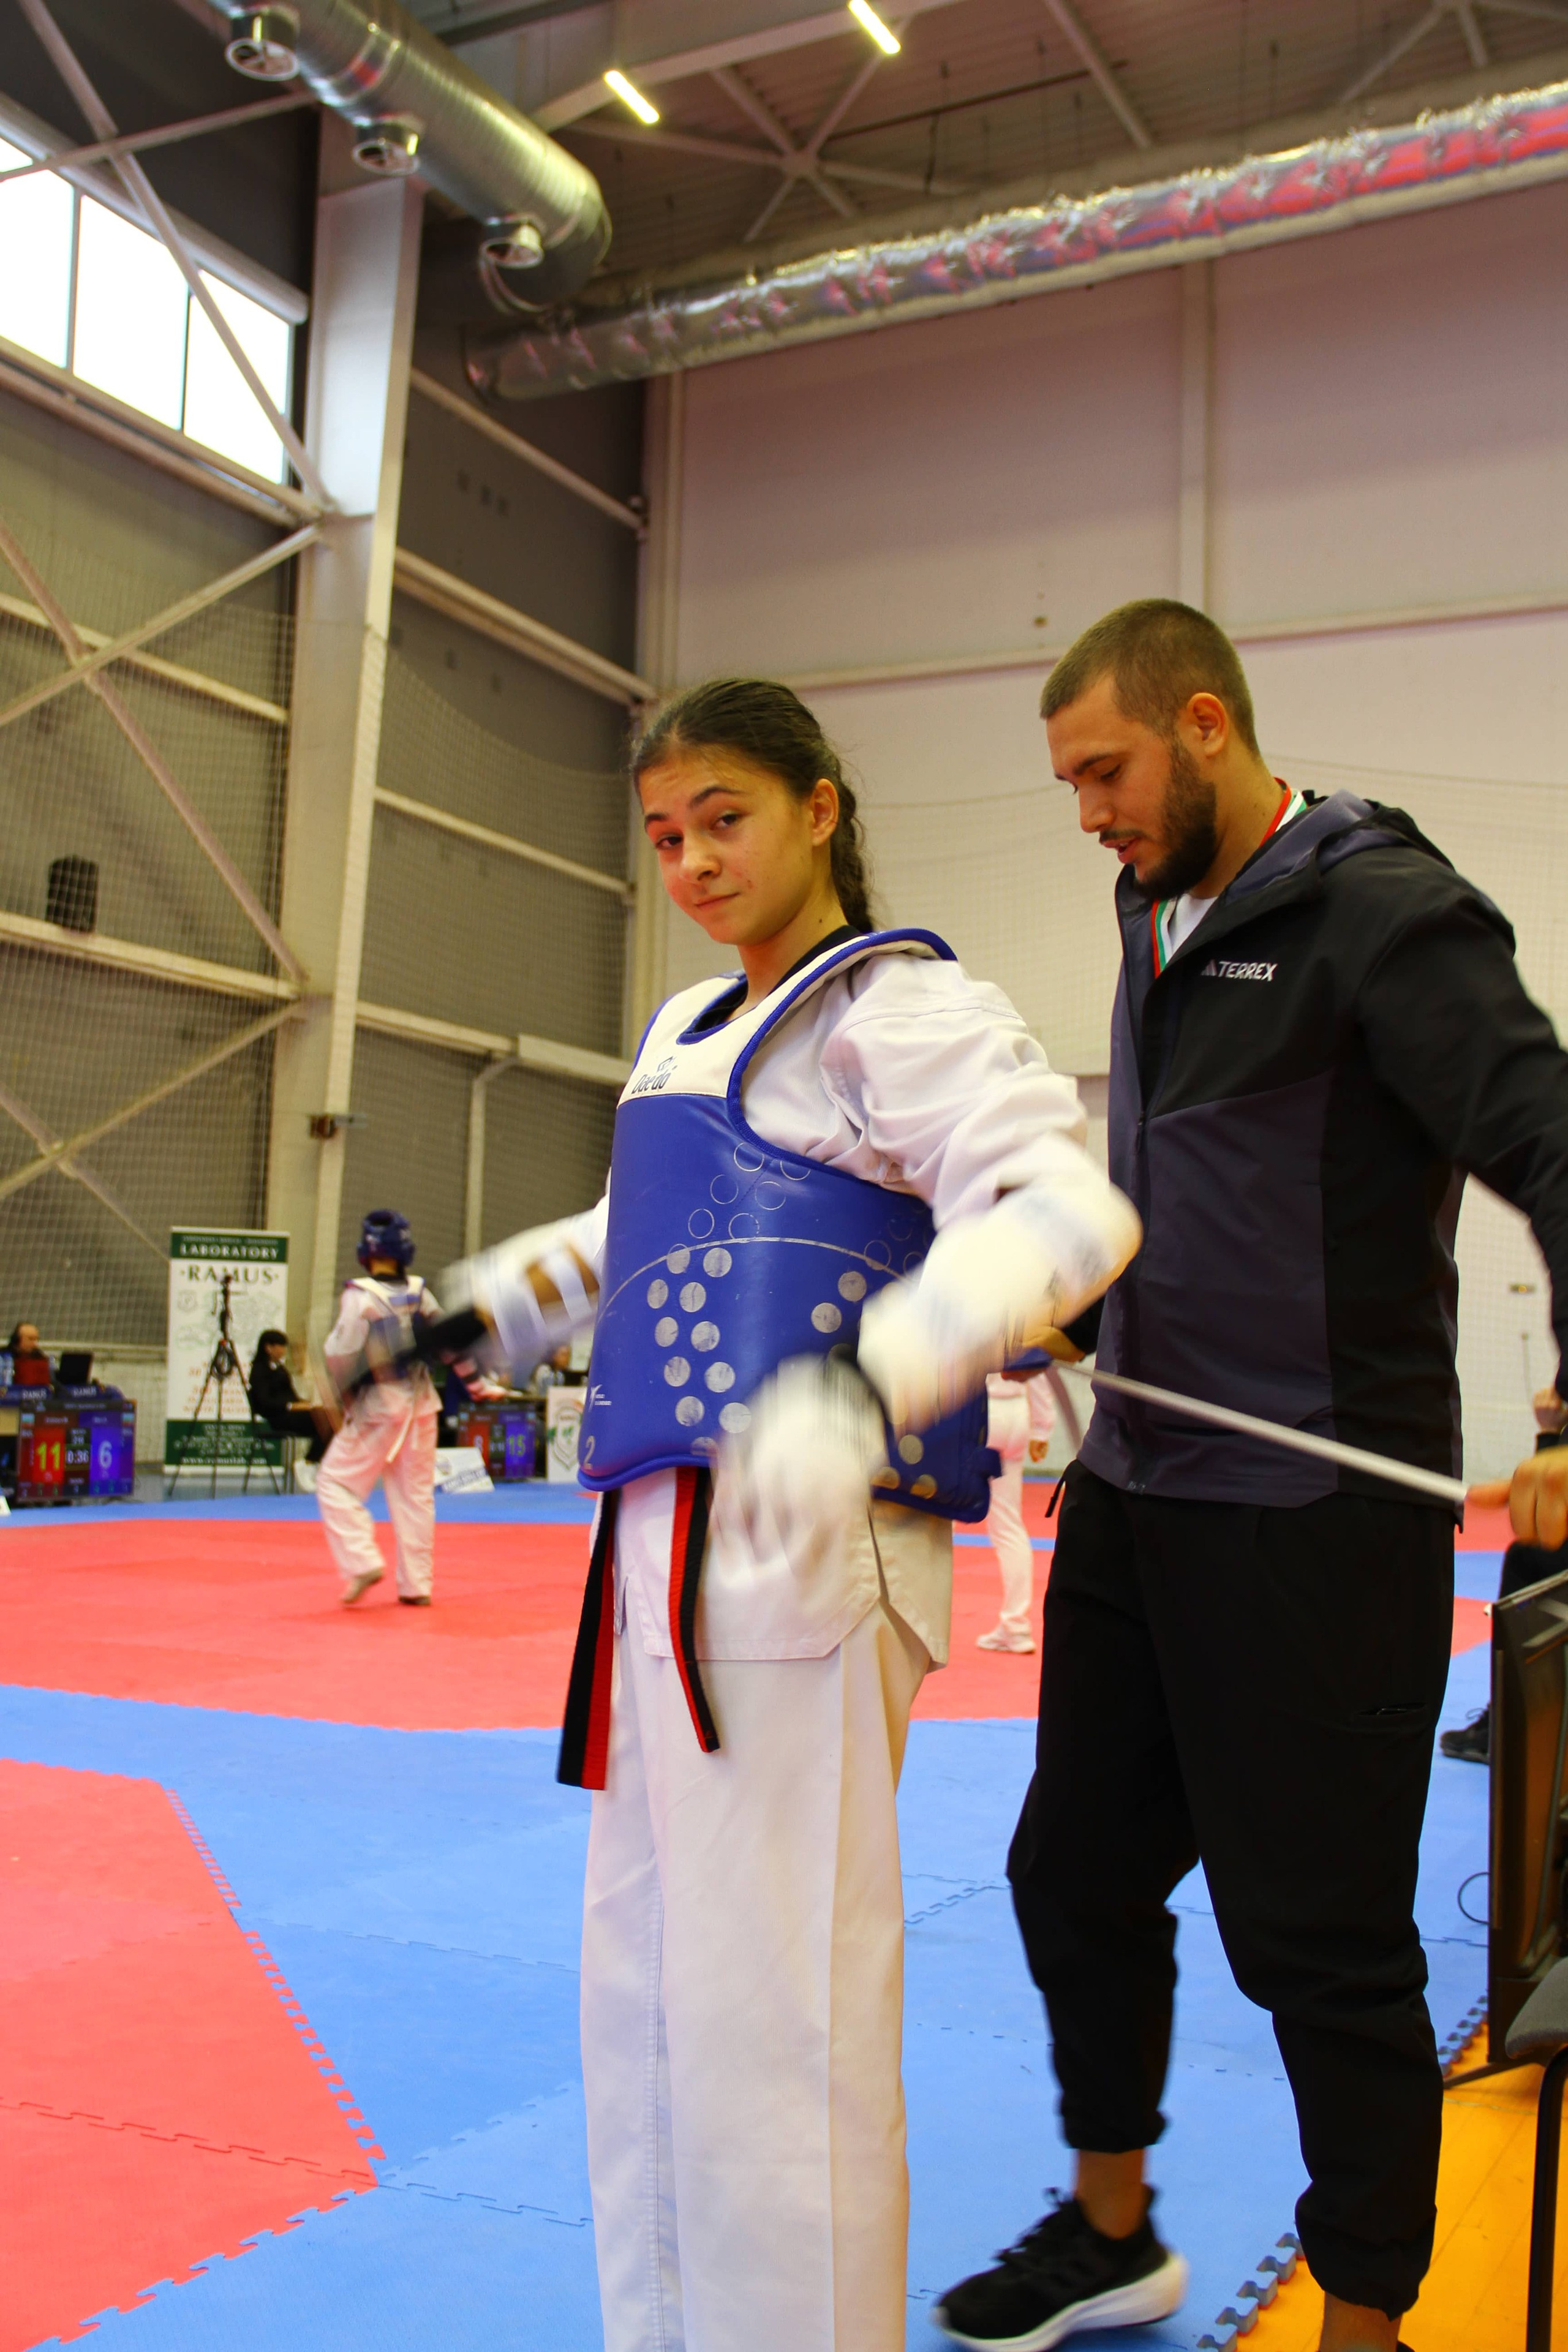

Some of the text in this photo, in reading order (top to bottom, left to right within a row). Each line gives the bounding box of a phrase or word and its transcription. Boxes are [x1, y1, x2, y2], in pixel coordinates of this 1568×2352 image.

[1218, 960, 1278, 981] TERREX
[181, 1244, 278, 1259] LABORATORY
[37, 1442, 61, 1470] 11
[98, 1441, 113, 1469] 6
[508, 1434, 526, 1456] 15
[584, 1435, 596, 1470] 2
[66, 1449, 89, 1464] 0:36
